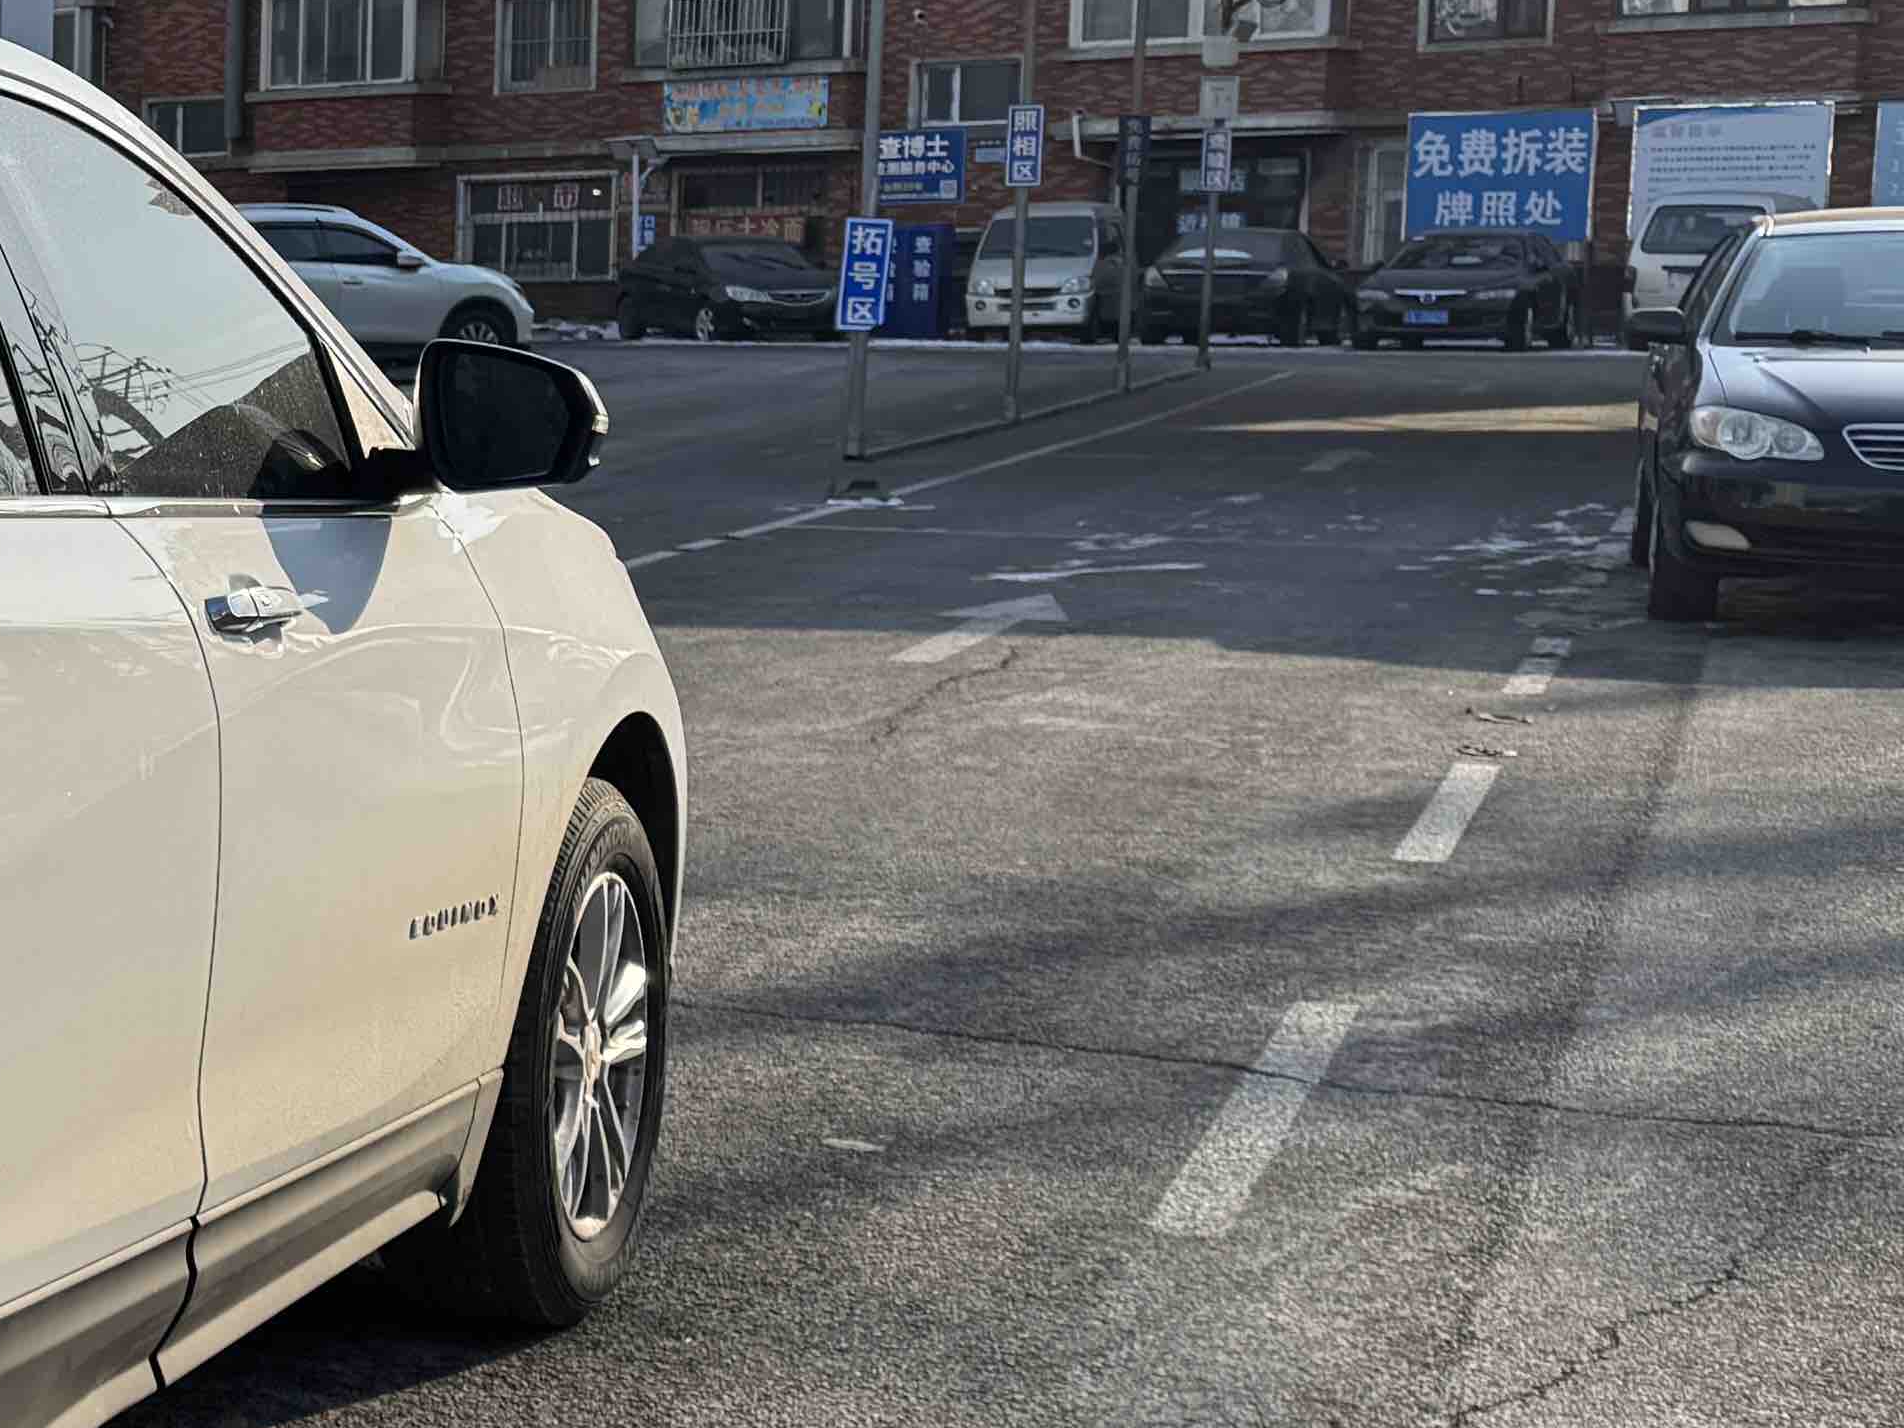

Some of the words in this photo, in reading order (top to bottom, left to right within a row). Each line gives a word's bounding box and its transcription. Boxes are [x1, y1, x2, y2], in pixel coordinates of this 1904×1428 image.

[1012, 110, 1038, 181] 照相区
[1413, 127, 1589, 177] 免费拆装
[1435, 189, 1564, 228] 牌照处
[847, 225, 886, 324] 拓号区
